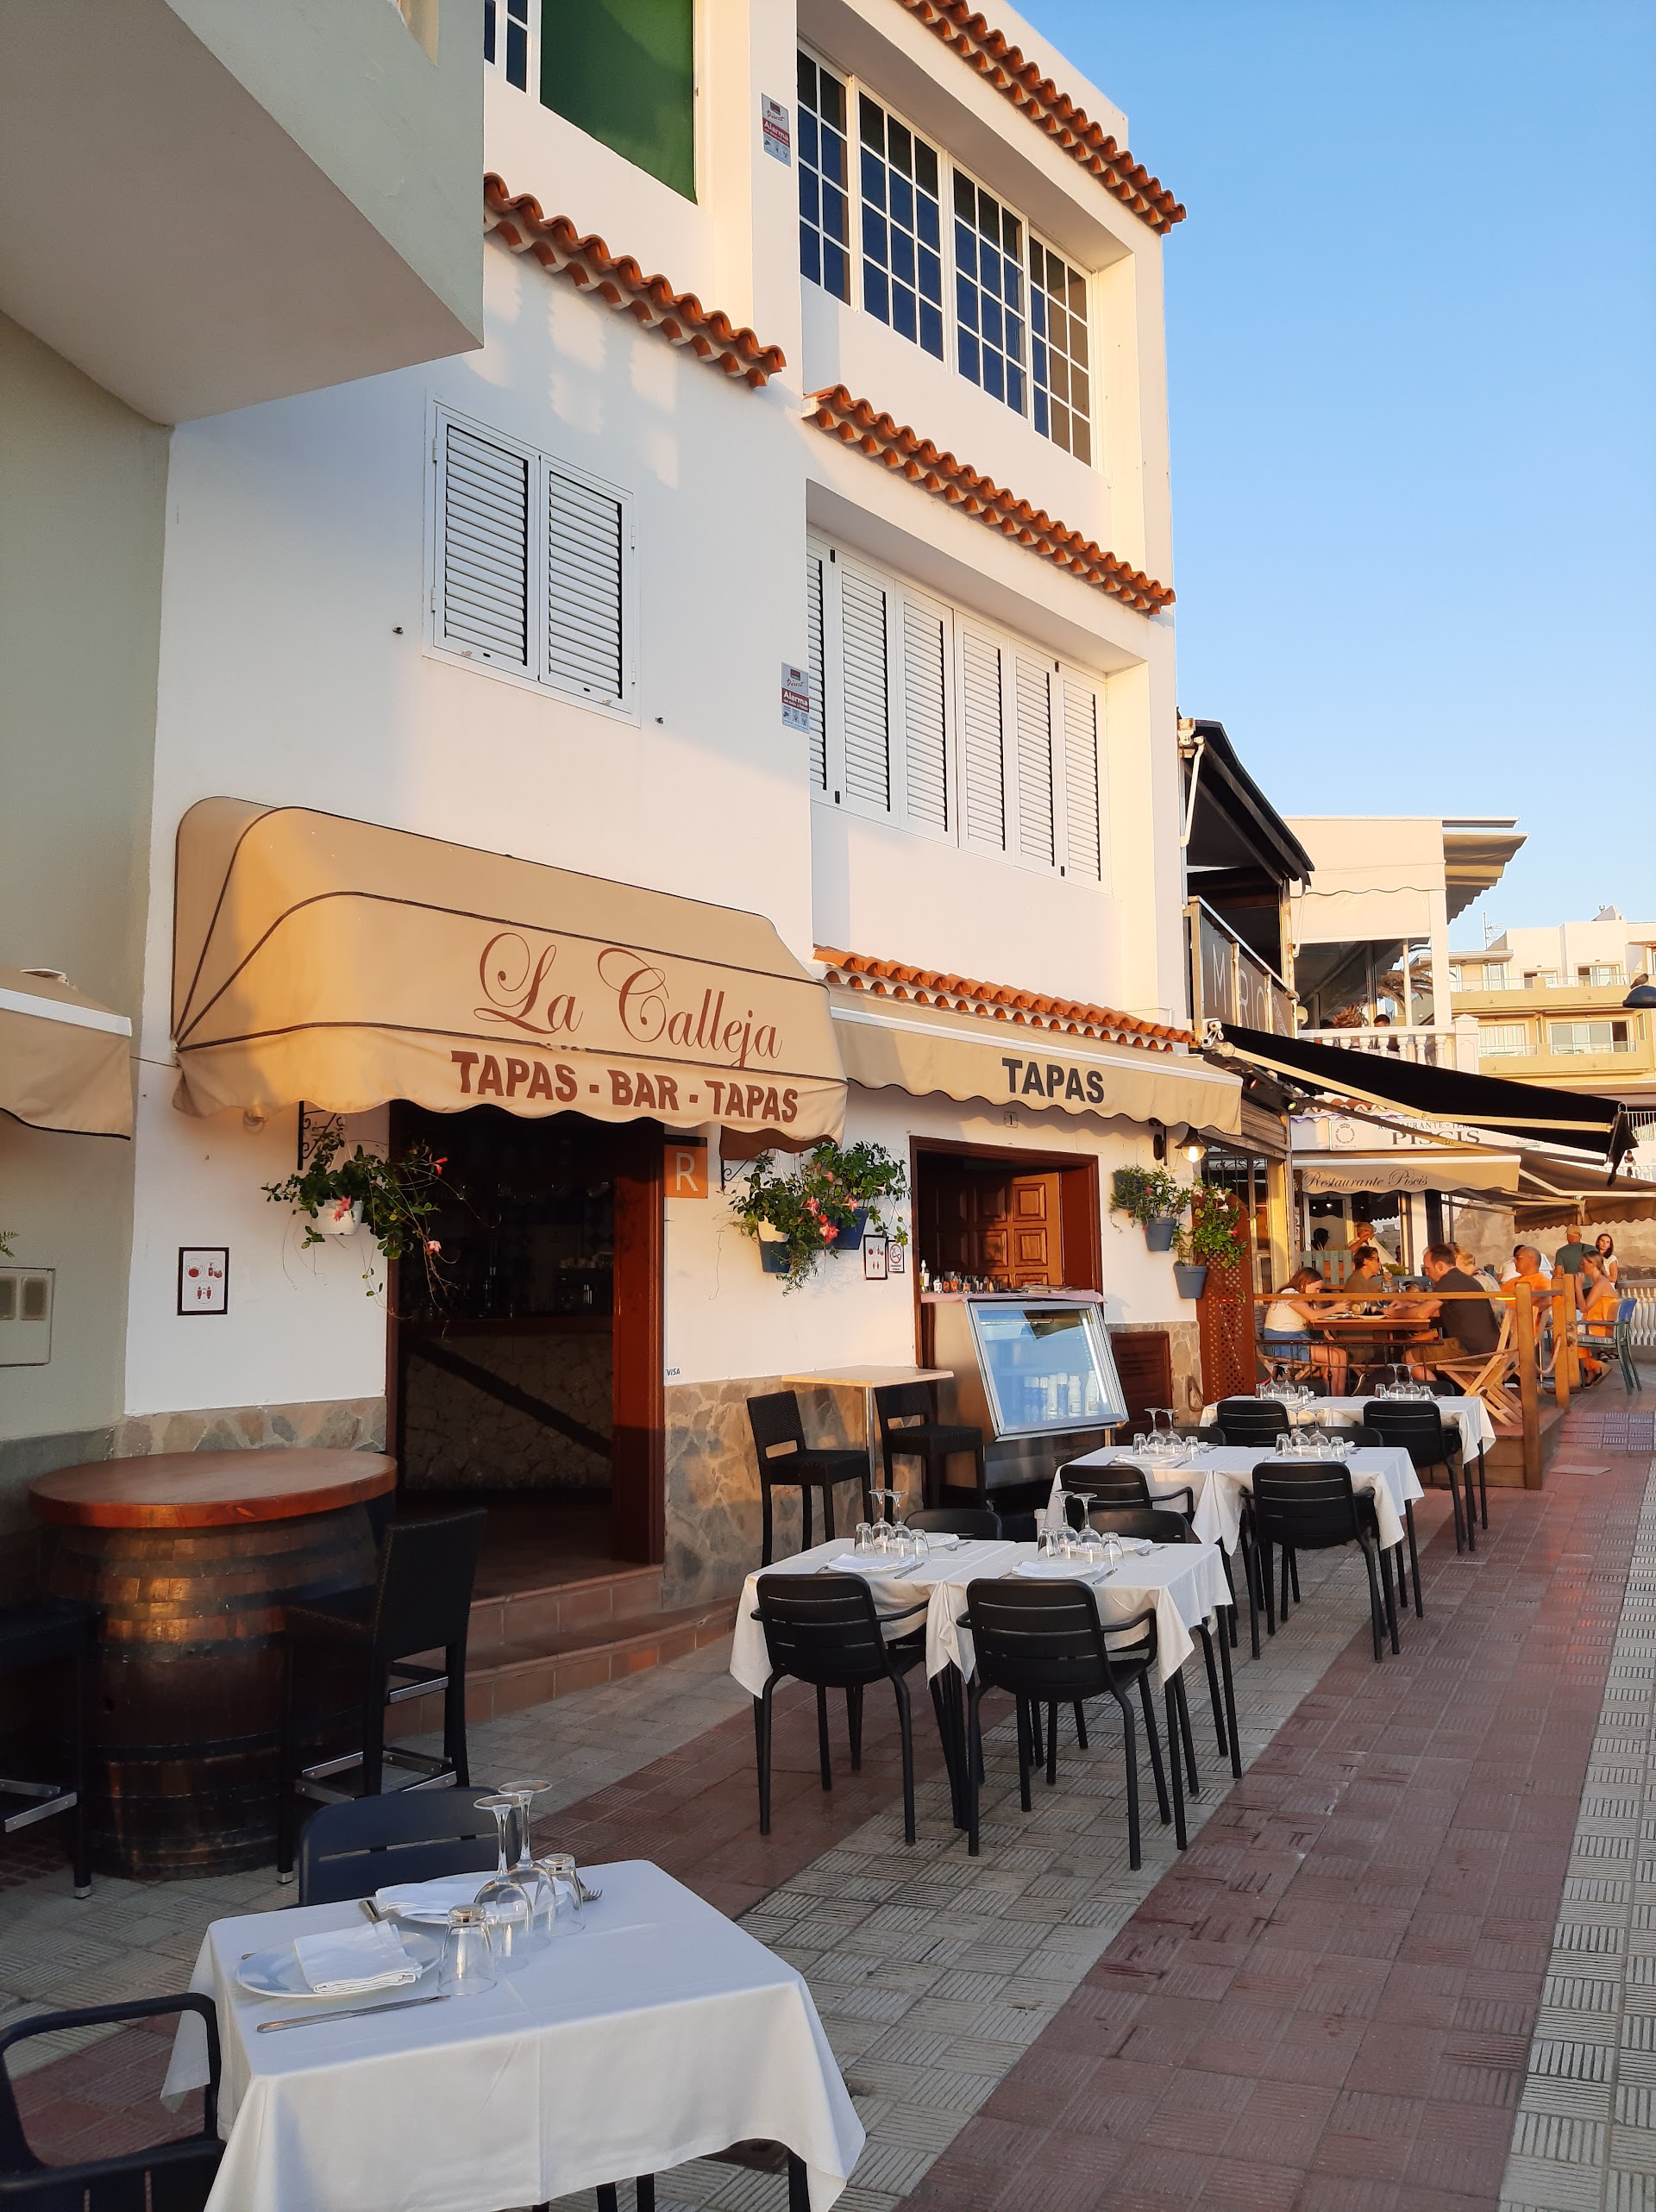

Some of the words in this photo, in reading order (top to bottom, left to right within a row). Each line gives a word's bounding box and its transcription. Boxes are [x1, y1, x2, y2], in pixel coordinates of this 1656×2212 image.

[764, 121, 788, 140] Alarma
[783, 691, 807, 705] Alarma
[474, 932, 584, 1035] La
[598, 948, 783, 1068] Calleja
[451, 1050, 578, 1103] TAPAS
[607, 1068, 680, 1112] BAR
[704, 1079, 799, 1123] TAPAS
[1001, 1056, 1105, 1104] TAPAS
[676, 1152, 699, 1192] R
[1302, 1169, 1383, 1188] Restaurante
[1389, 1169, 1428, 1187] Piscis
